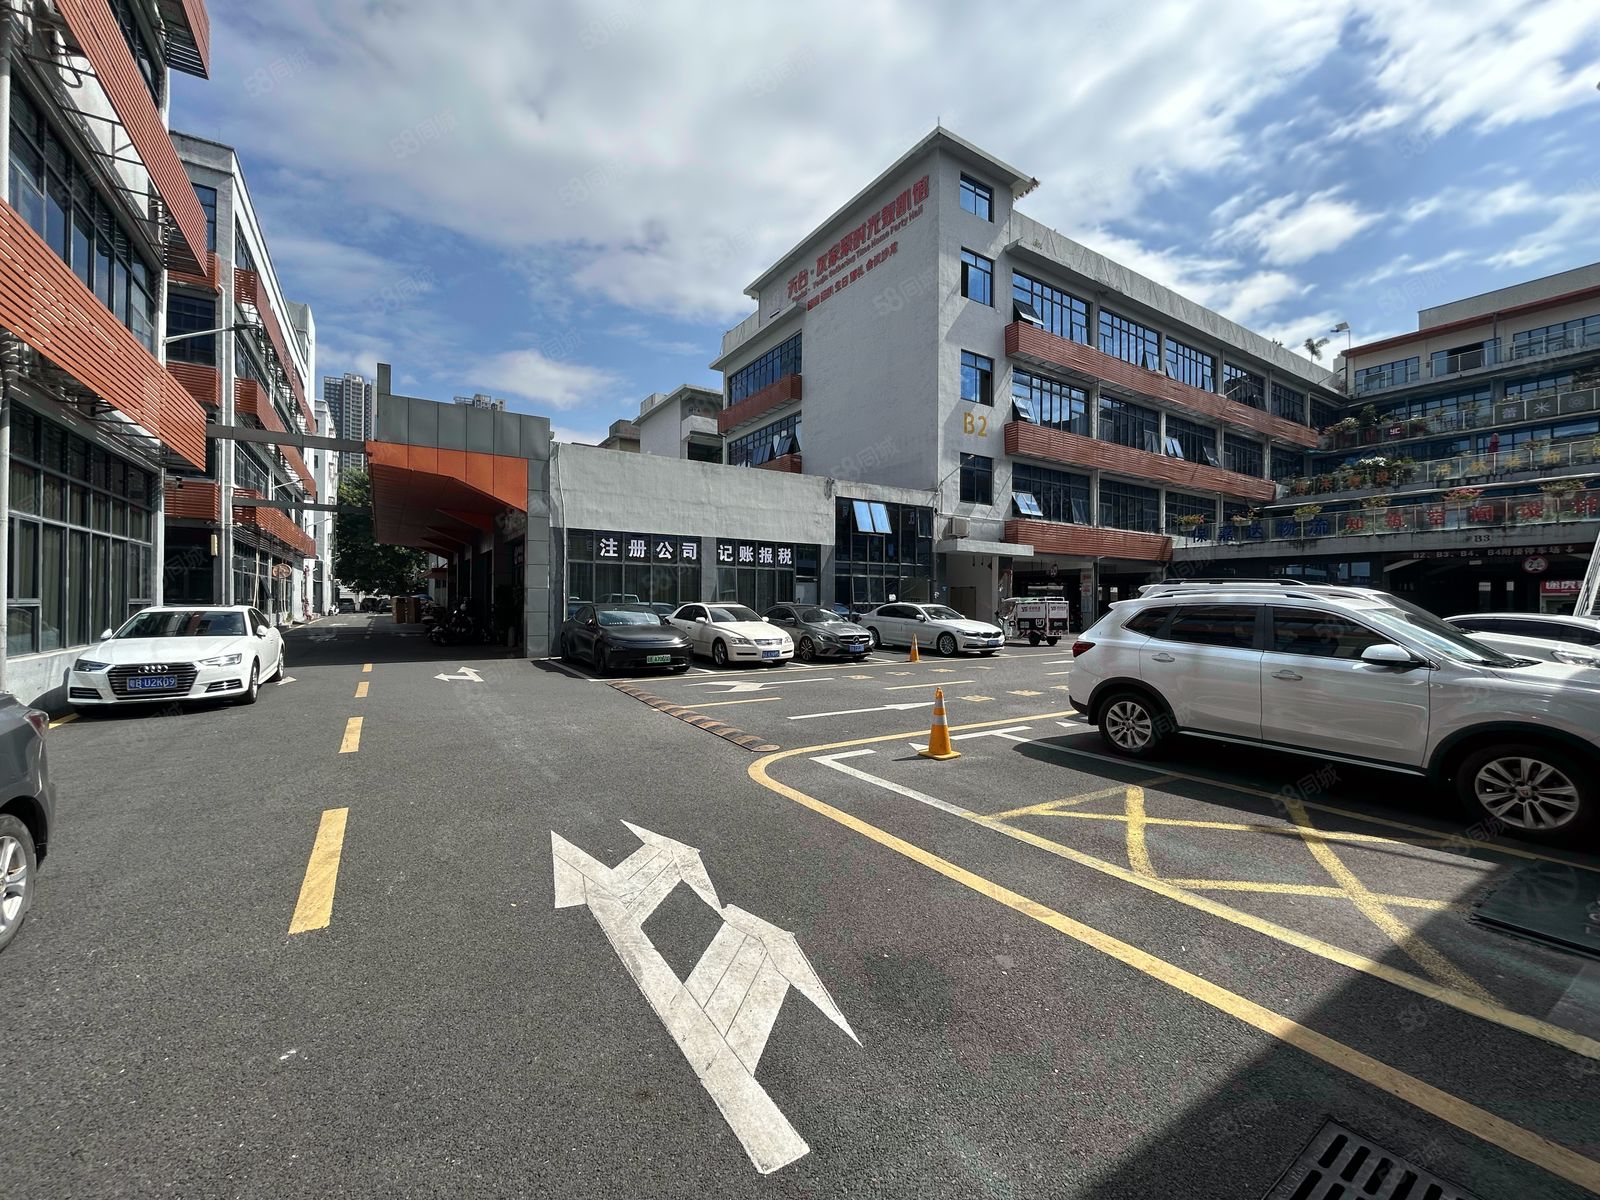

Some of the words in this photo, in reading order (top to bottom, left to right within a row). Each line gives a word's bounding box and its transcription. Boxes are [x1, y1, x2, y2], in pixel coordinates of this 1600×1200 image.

[964, 411, 987, 436] B2
[600, 538, 697, 560] 注册公司
[718, 545, 792, 565] 记账报税
[1474, 535, 1490, 543] B3
